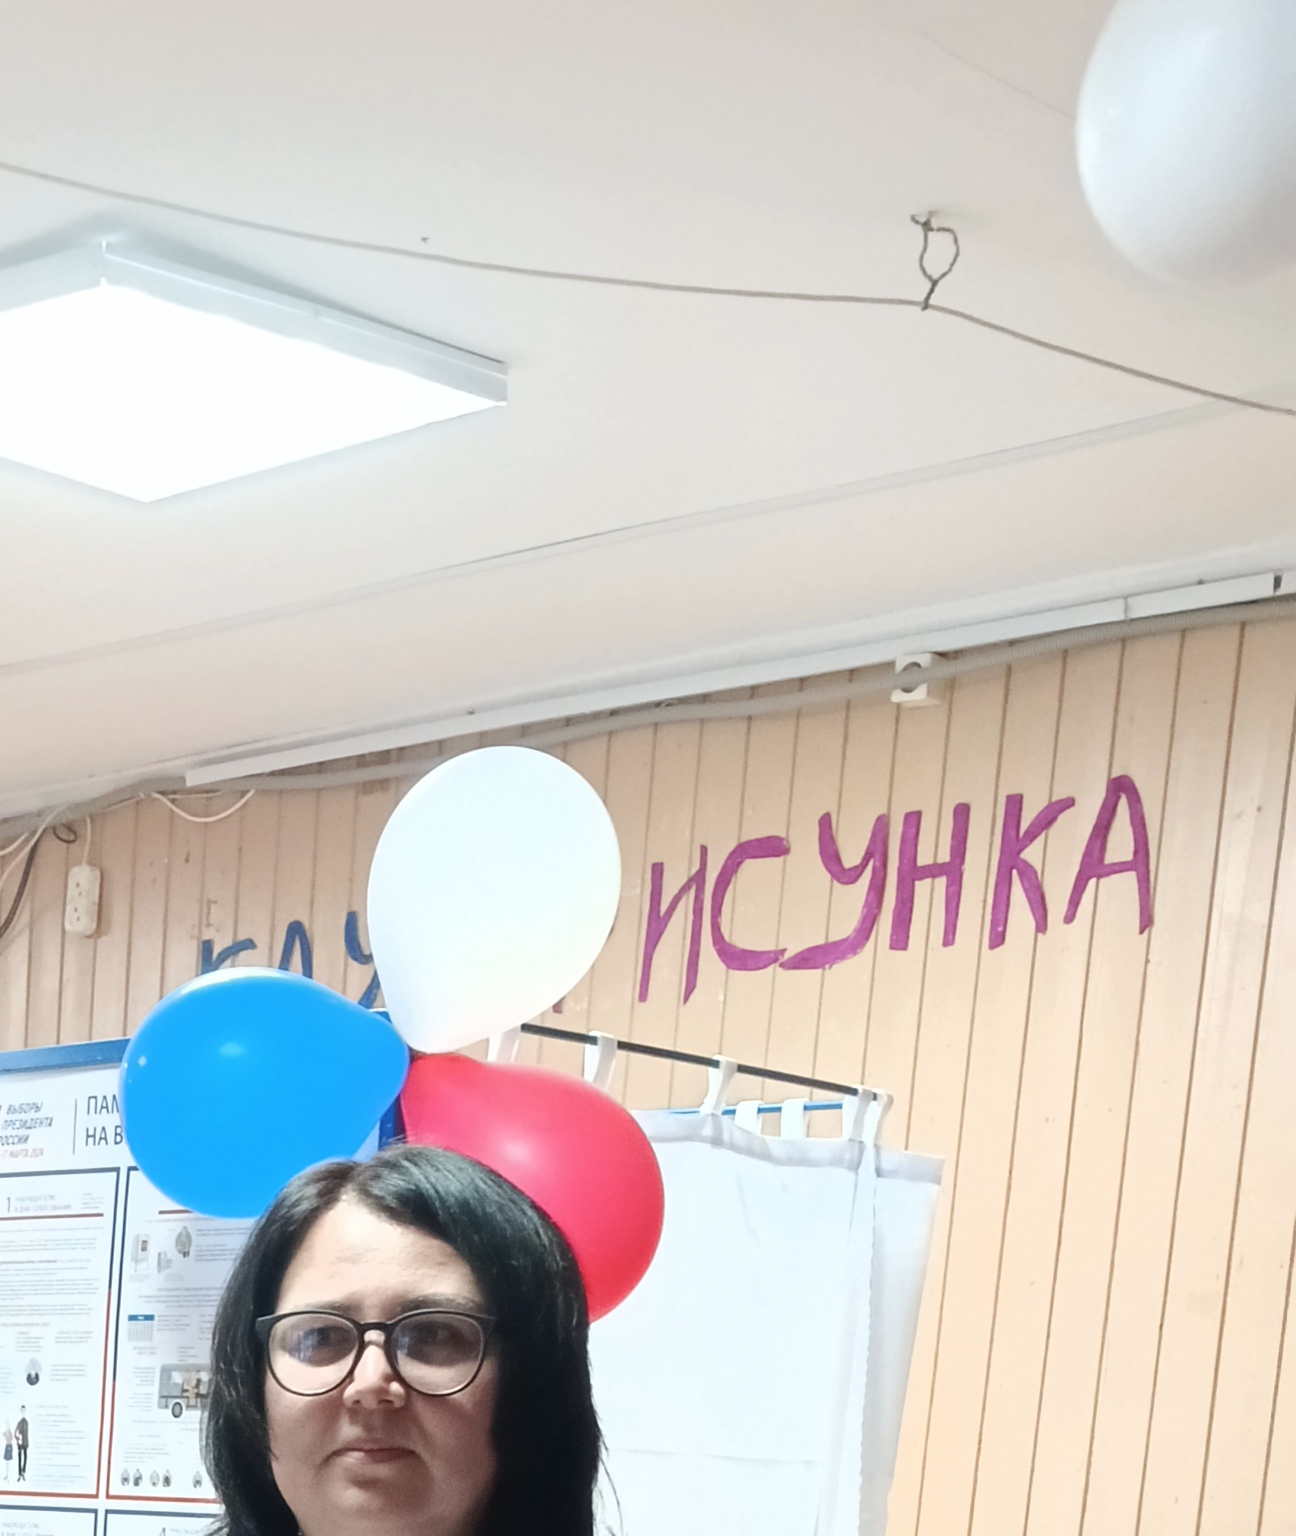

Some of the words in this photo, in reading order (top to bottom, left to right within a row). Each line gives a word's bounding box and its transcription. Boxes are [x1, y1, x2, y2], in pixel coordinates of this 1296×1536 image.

[200, 911, 382, 1010] КЛУ
[553, 774, 1153, 1013] ИСУНКА
[6, 1102, 44, 1116] ВЫБОРЫ
[87, 1094, 120, 1116] ПАМ
[2, 1116, 54, 1131] ПРЕЗИДЕНТА
[85, 1126, 109, 1147] НА
[113, 1125, 124, 1146] В
